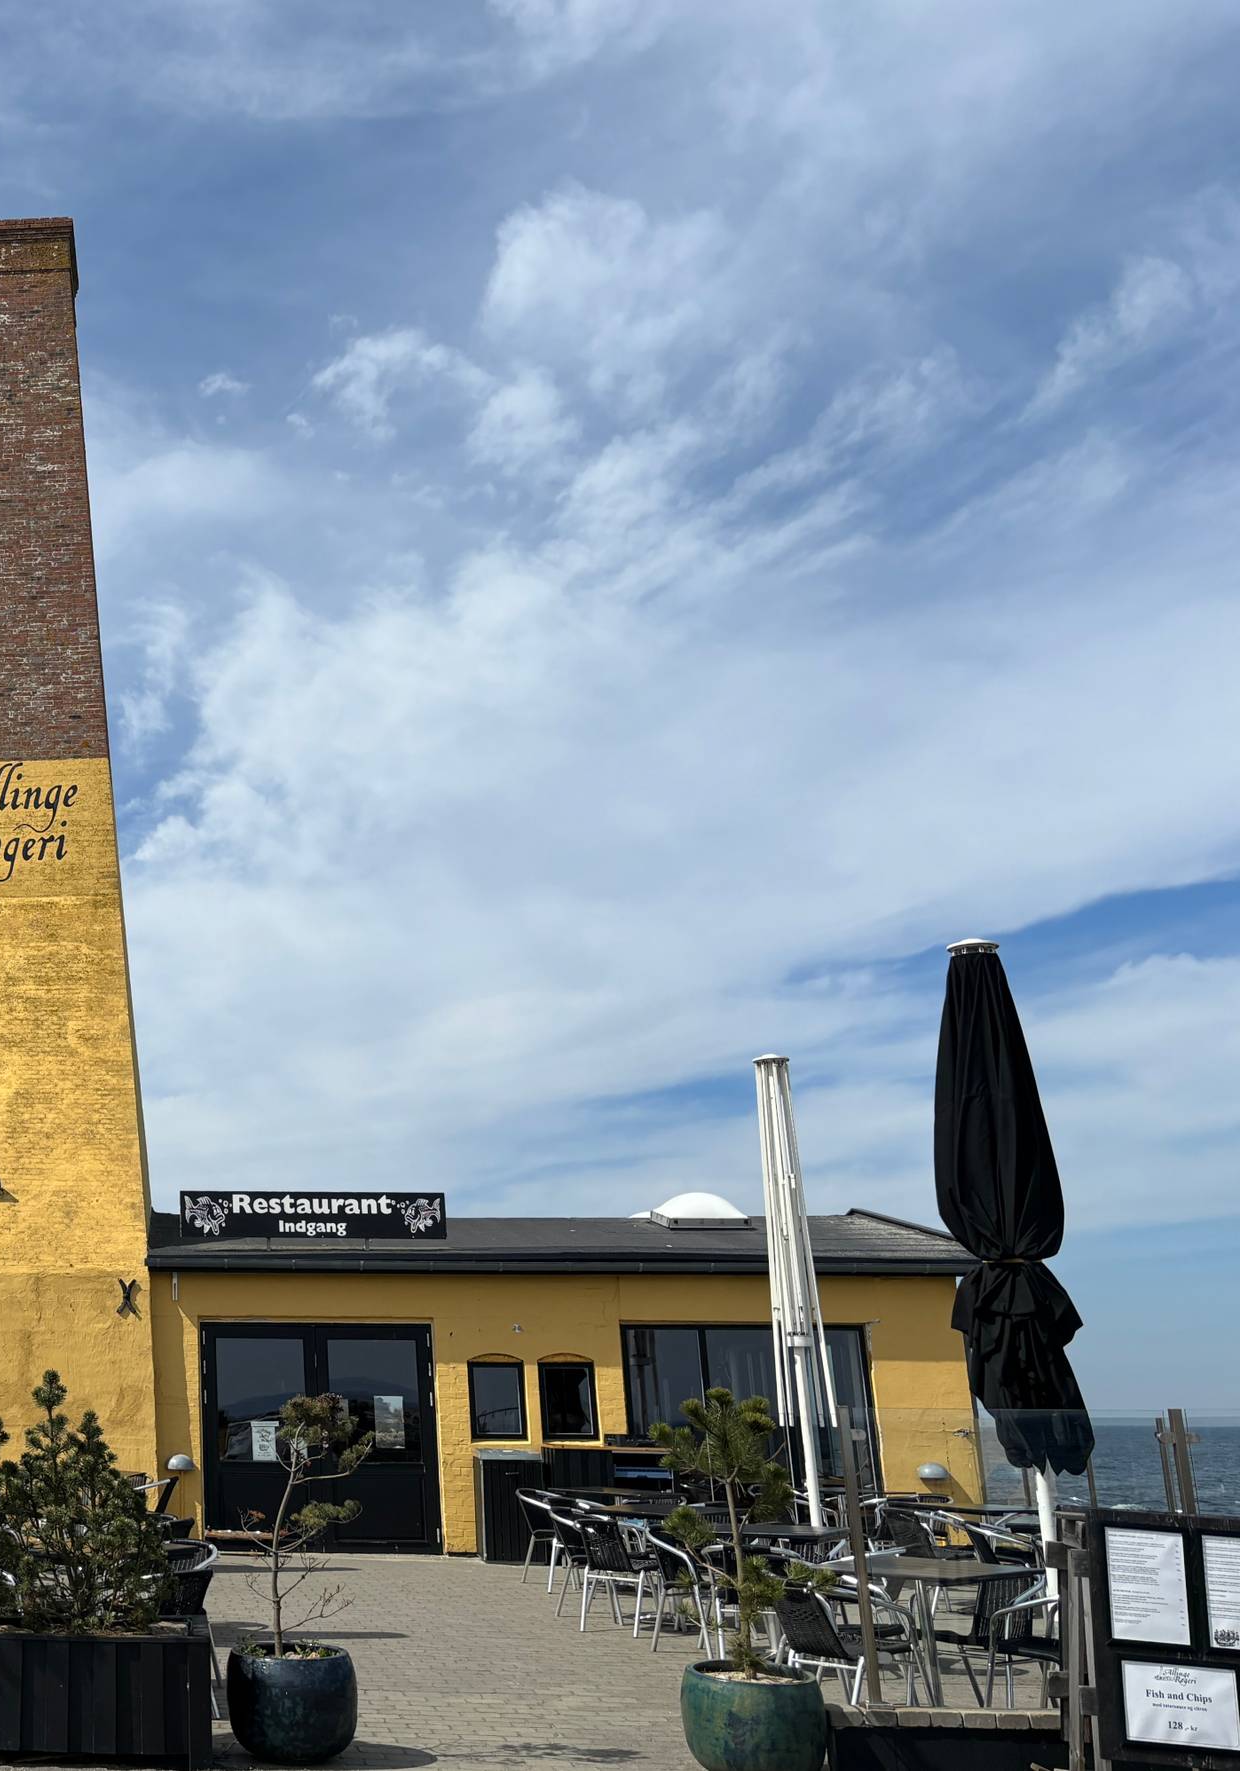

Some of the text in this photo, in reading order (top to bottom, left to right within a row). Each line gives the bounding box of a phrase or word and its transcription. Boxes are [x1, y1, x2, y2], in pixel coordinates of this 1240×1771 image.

[231, 1193, 392, 1215] Restaurant
[278, 1220, 347, 1236] Indgang
[1145, 1689, 1213, 1704] Fish and Chips
[1168, 1720, 1183, 1730] 128
